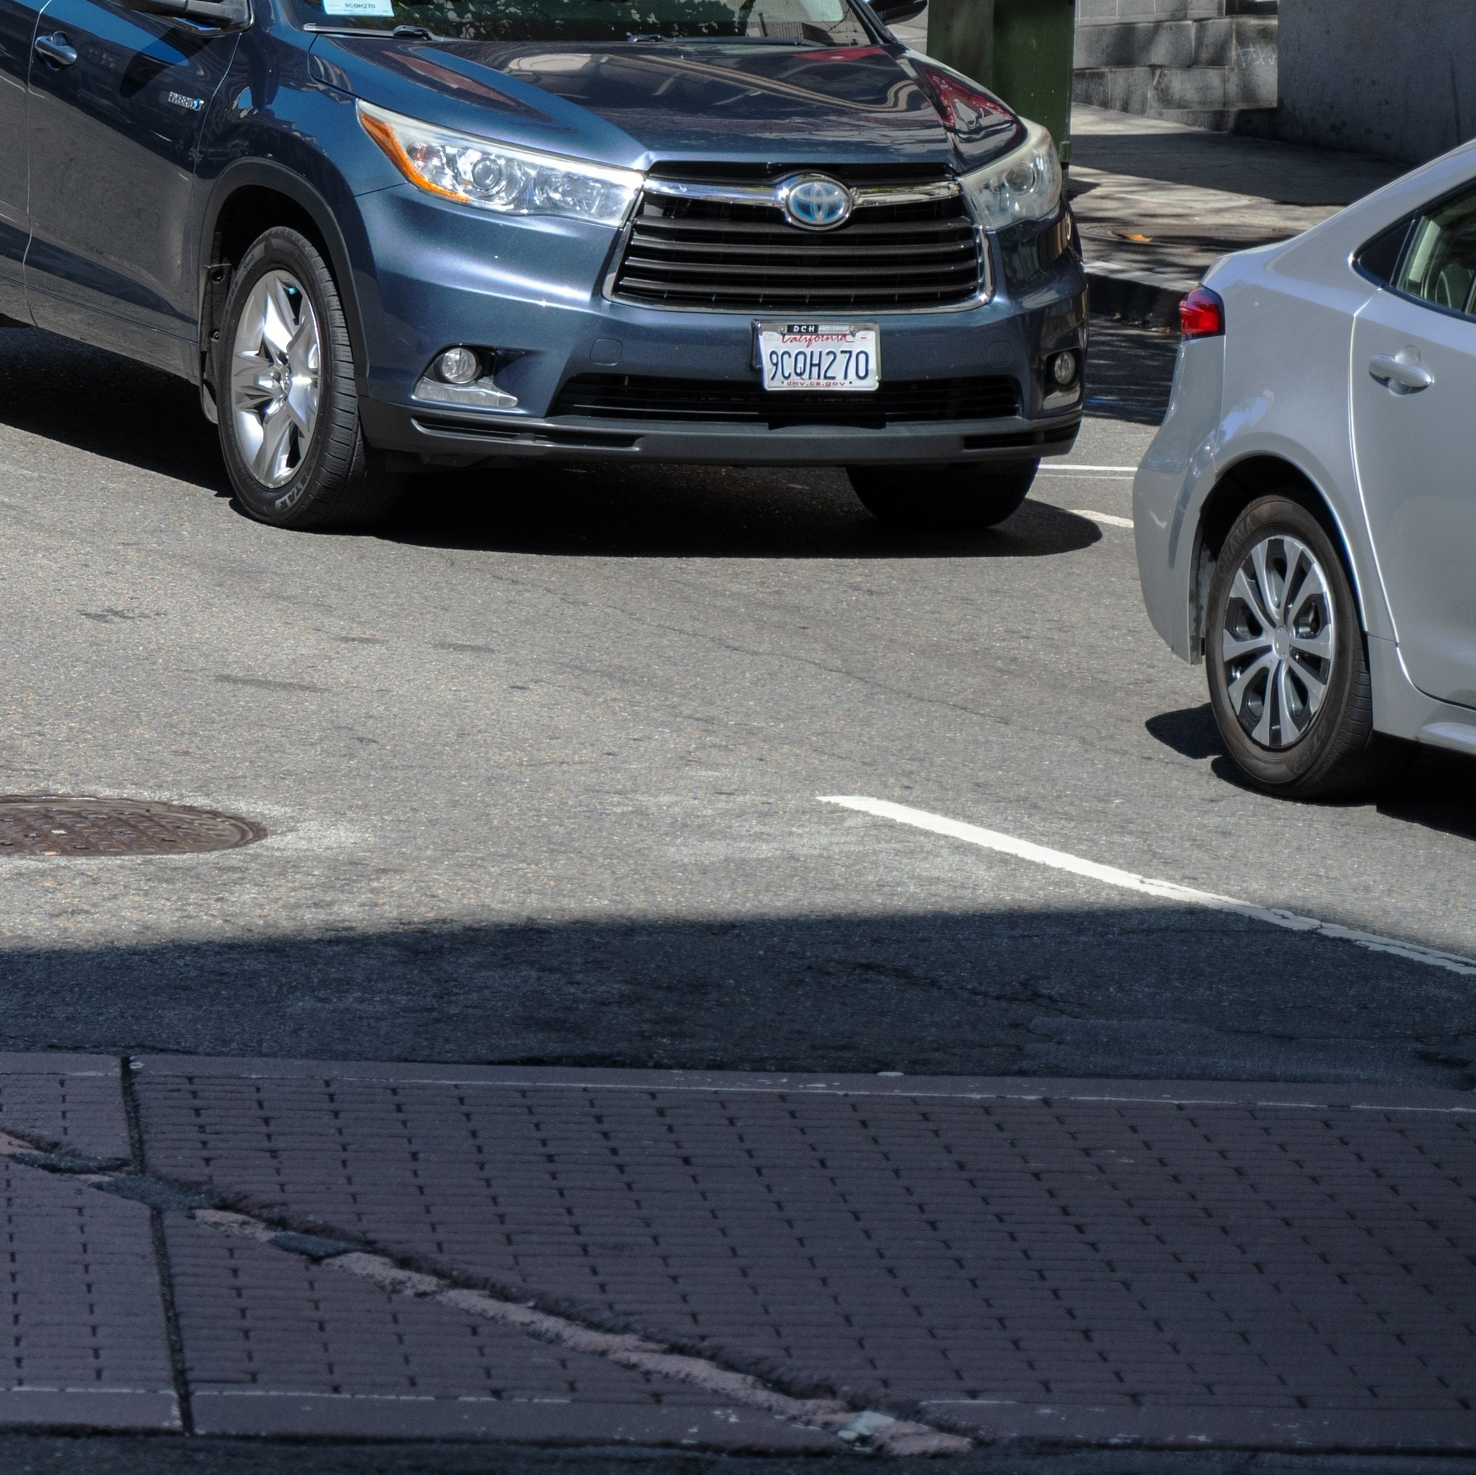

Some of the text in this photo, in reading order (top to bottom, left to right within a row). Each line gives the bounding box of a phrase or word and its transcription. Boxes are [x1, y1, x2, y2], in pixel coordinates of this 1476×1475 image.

[781, 332, 856, 349] California
[769, 350, 870, 381] 9CQH270
[786, 380, 846, 388] dmv.ca.gov
